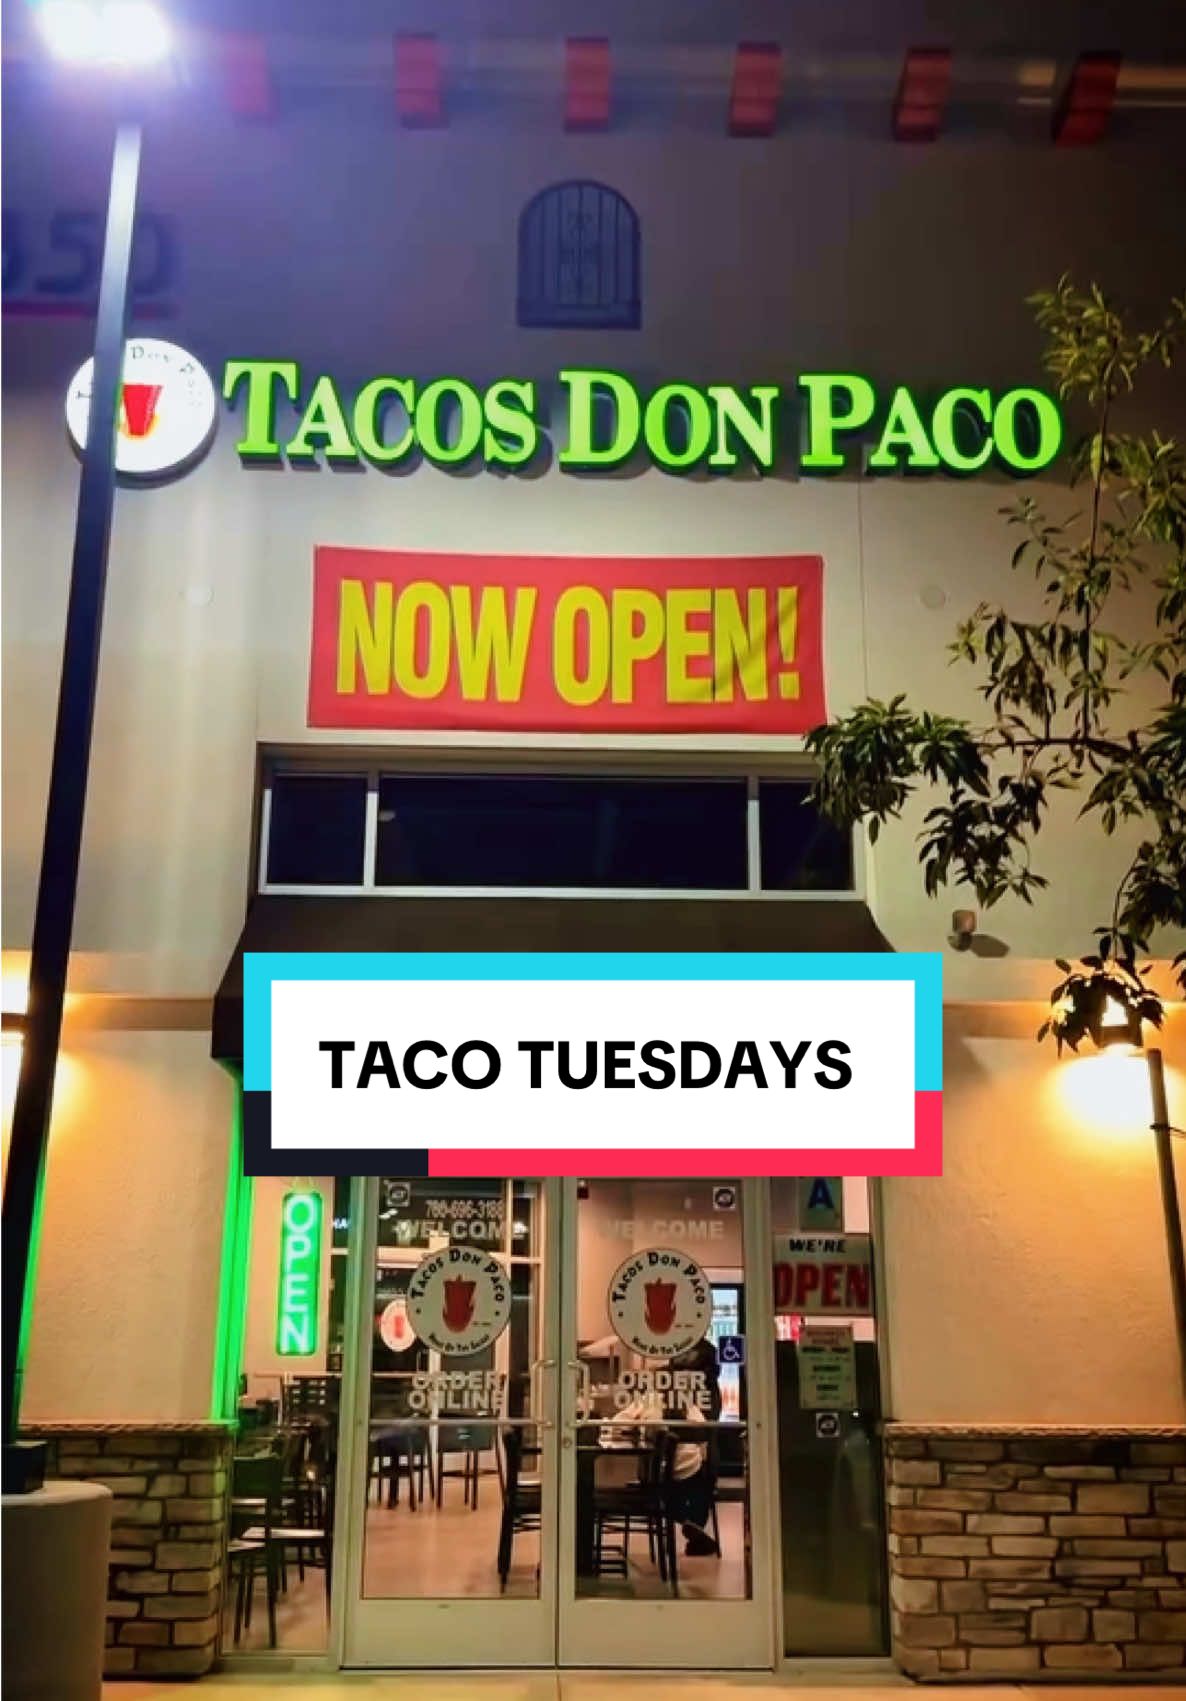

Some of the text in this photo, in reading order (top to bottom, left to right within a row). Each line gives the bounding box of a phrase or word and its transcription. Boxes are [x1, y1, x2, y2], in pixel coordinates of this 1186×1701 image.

[223, 360, 537, 466] TACOS
[558, 370, 780, 470] DON
[798, 374, 1063, 472] PACO
[336, 579, 800, 706] NOW OPEN!
[807, 1177, 834, 1209] A
[608, 1221, 723, 1240] WECOME
[449, 1248, 480, 1265] DON
[647, 1251, 680, 1268] DON
[280, 1194, 317, 1354] OPEN
[773, 1263, 870, 1308] OPEN
[619, 1371, 706, 1389] ORDER
